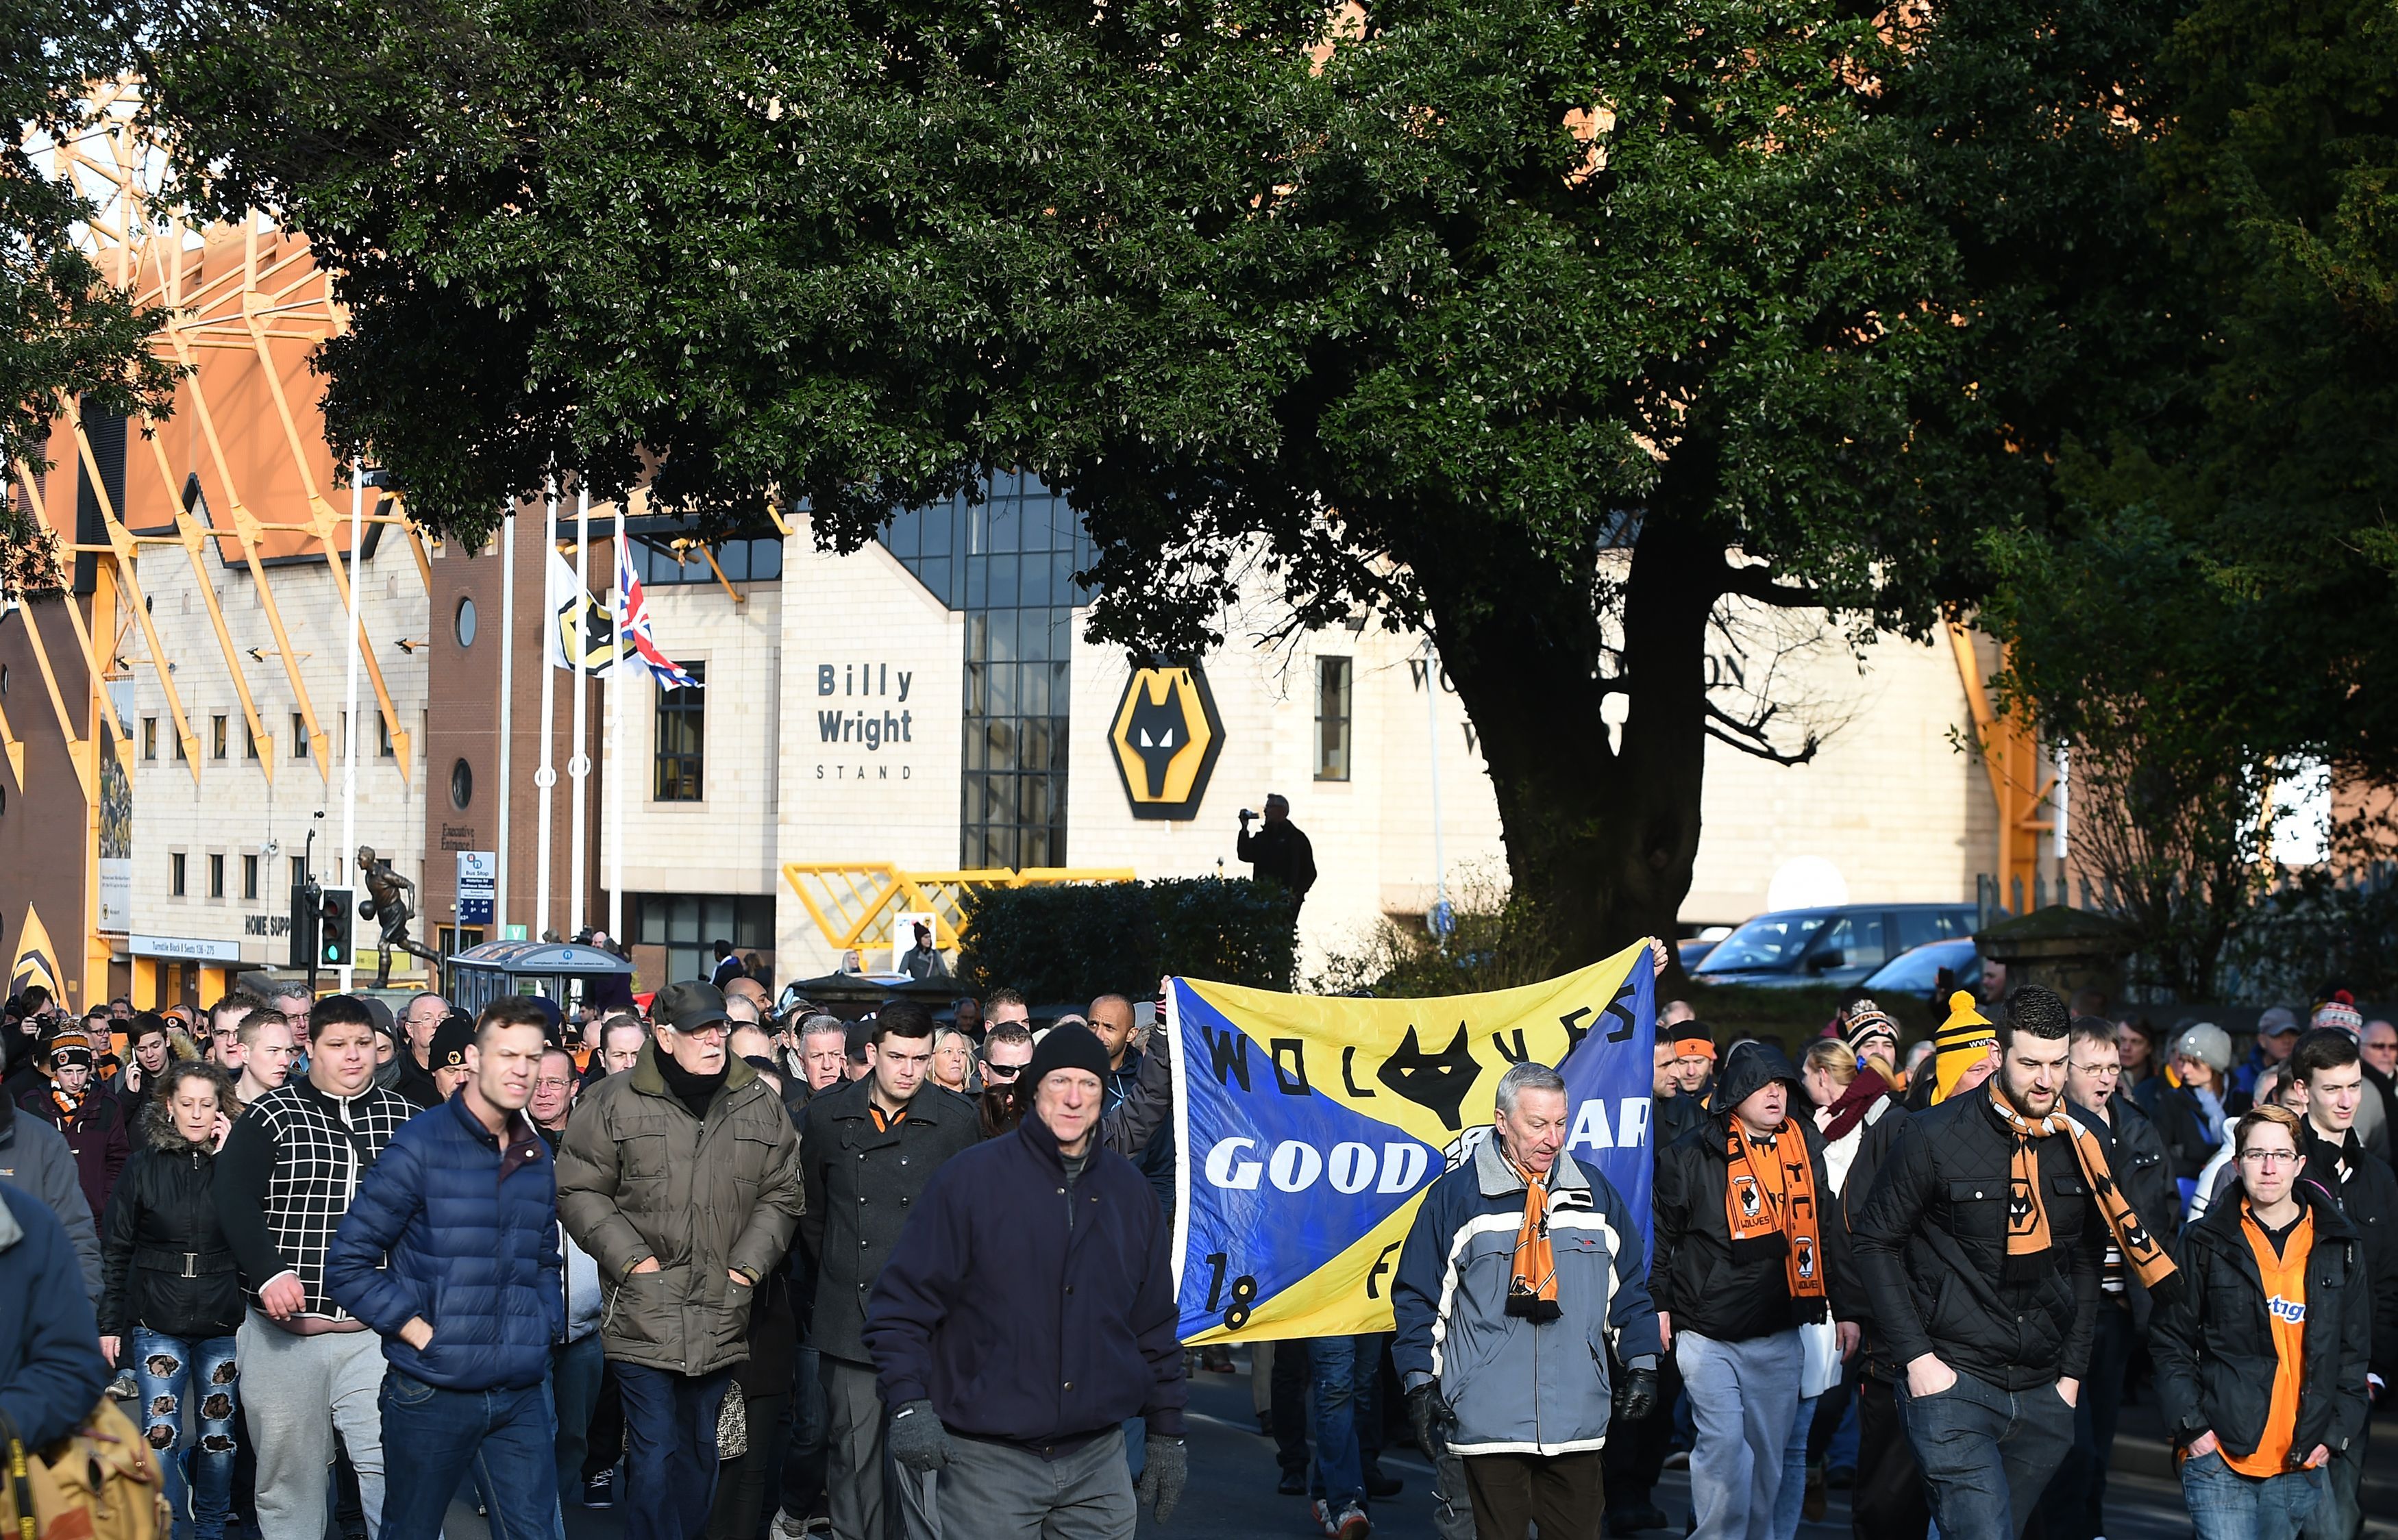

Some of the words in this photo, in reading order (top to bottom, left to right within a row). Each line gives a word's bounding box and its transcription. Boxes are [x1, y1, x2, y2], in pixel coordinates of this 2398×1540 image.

[818, 663, 912, 702] Billy
[818, 710, 912, 751] Wright
[817, 765, 911, 780] STAND
[443, 823, 475, 837] Executive
[441, 837, 470, 850] Entrance
[245, 914, 267, 936] HOME
[152, 941, 169, 951] Turnstile
[169, 942, 180, 952] Block
[184, 943, 195, 953] Seats
[1204, 1137, 1428, 1194] GOOD
[1740, 1215, 1770, 1228] WOLVES
[1205, 1252, 1257, 1329] 18
